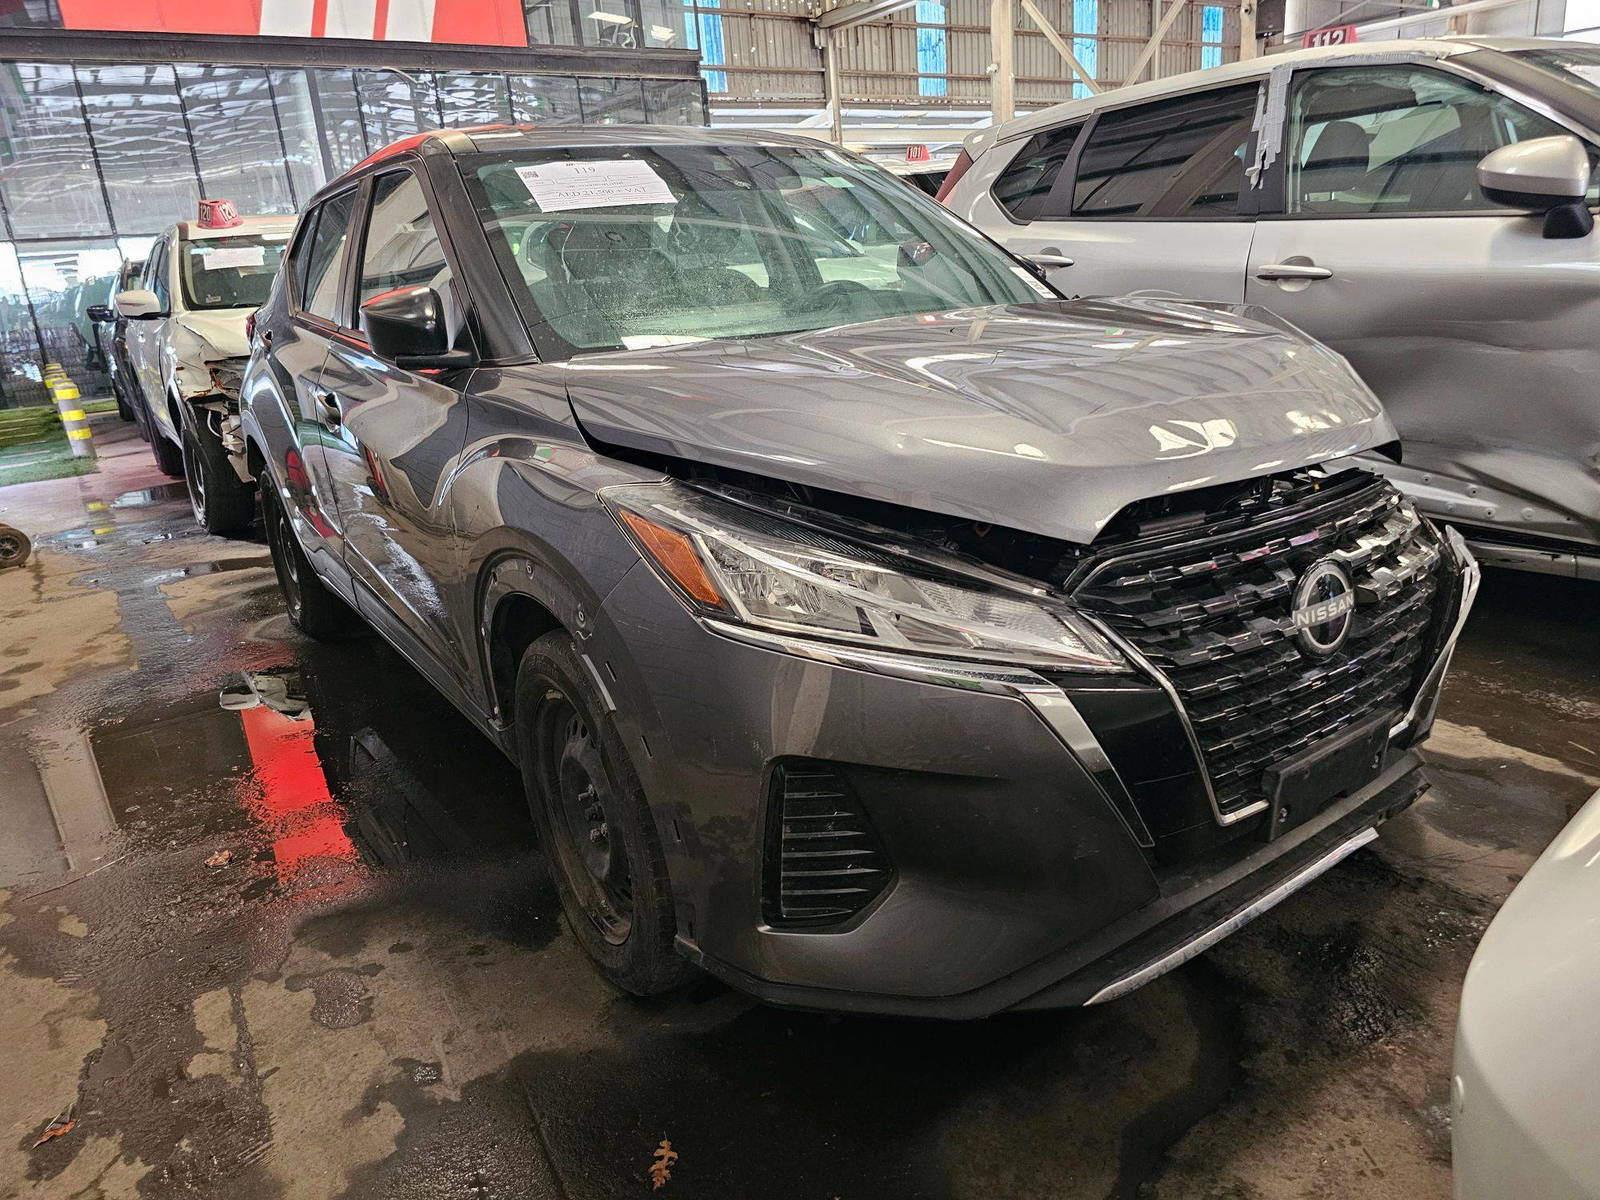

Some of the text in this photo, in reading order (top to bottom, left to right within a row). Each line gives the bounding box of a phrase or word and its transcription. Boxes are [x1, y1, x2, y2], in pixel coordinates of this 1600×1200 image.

[1312, 30, 1344, 48] 112
[574, 166, 596, 174] 119
[558, 190, 581, 199] AED
[623, 185, 647, 194] VAT
[200, 205, 211, 221] 120
[219, 201, 238, 222] 120
[1297, 593, 1355, 626] NISSAN
